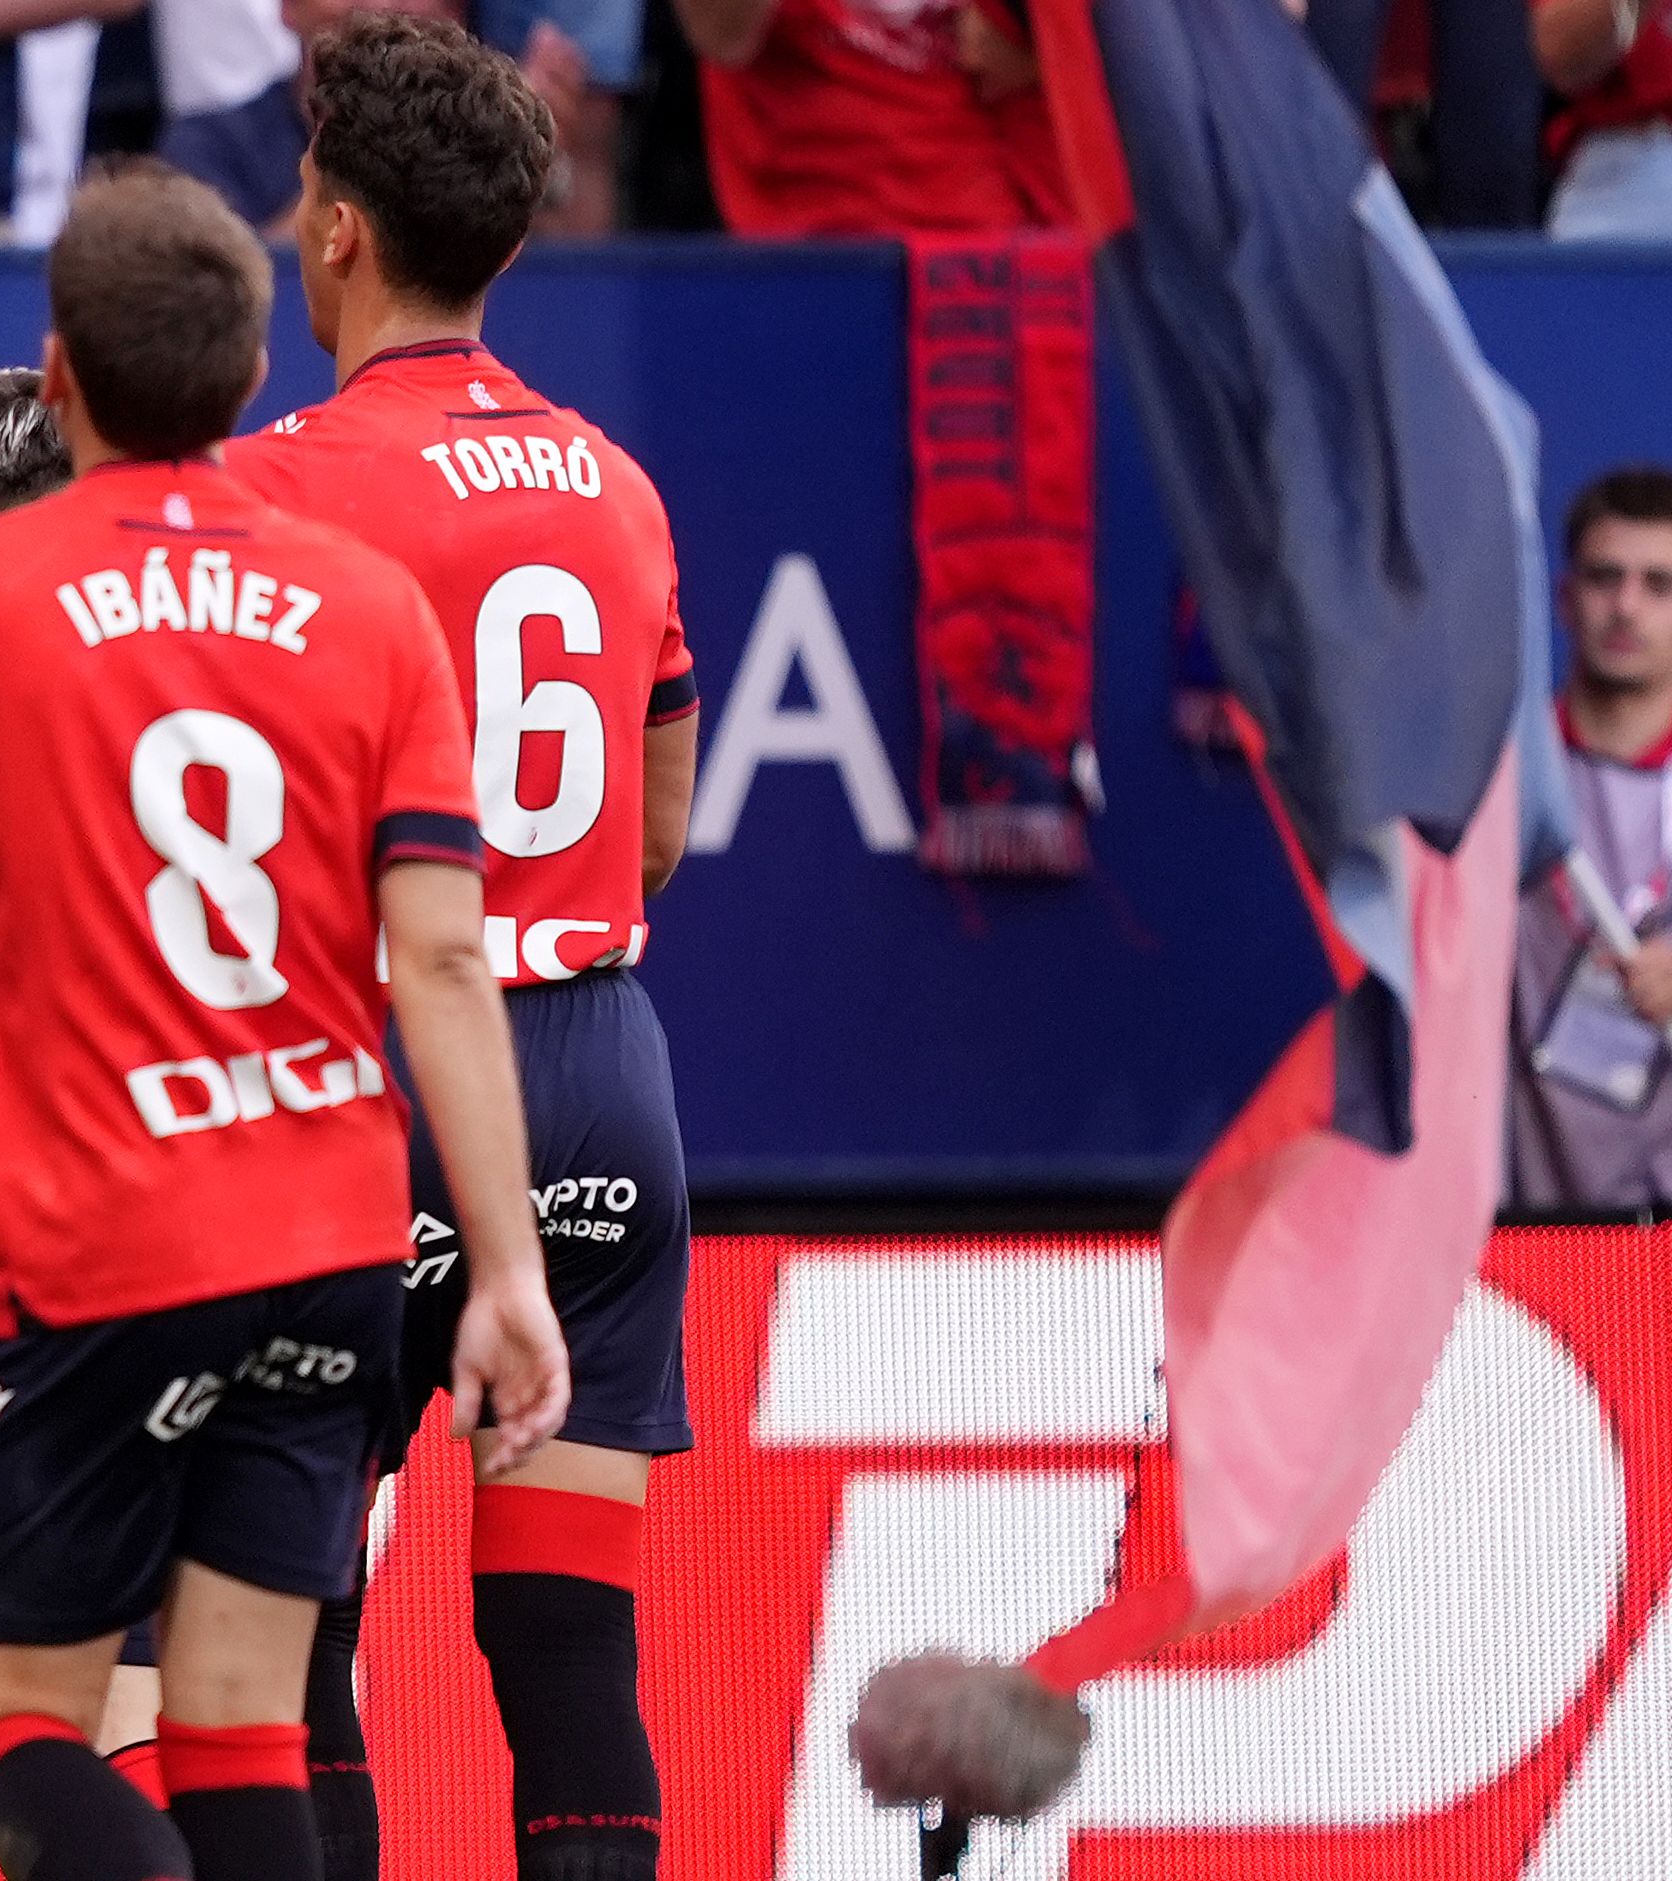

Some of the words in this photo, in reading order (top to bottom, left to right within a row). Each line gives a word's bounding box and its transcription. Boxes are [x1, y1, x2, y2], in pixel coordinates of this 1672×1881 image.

[421, 434, 603, 500] TORRÓ
[56, 546, 323, 656] IBÁÑEZ
[472, 564, 607, 858] 6
[129, 708, 290, 1012] 8
